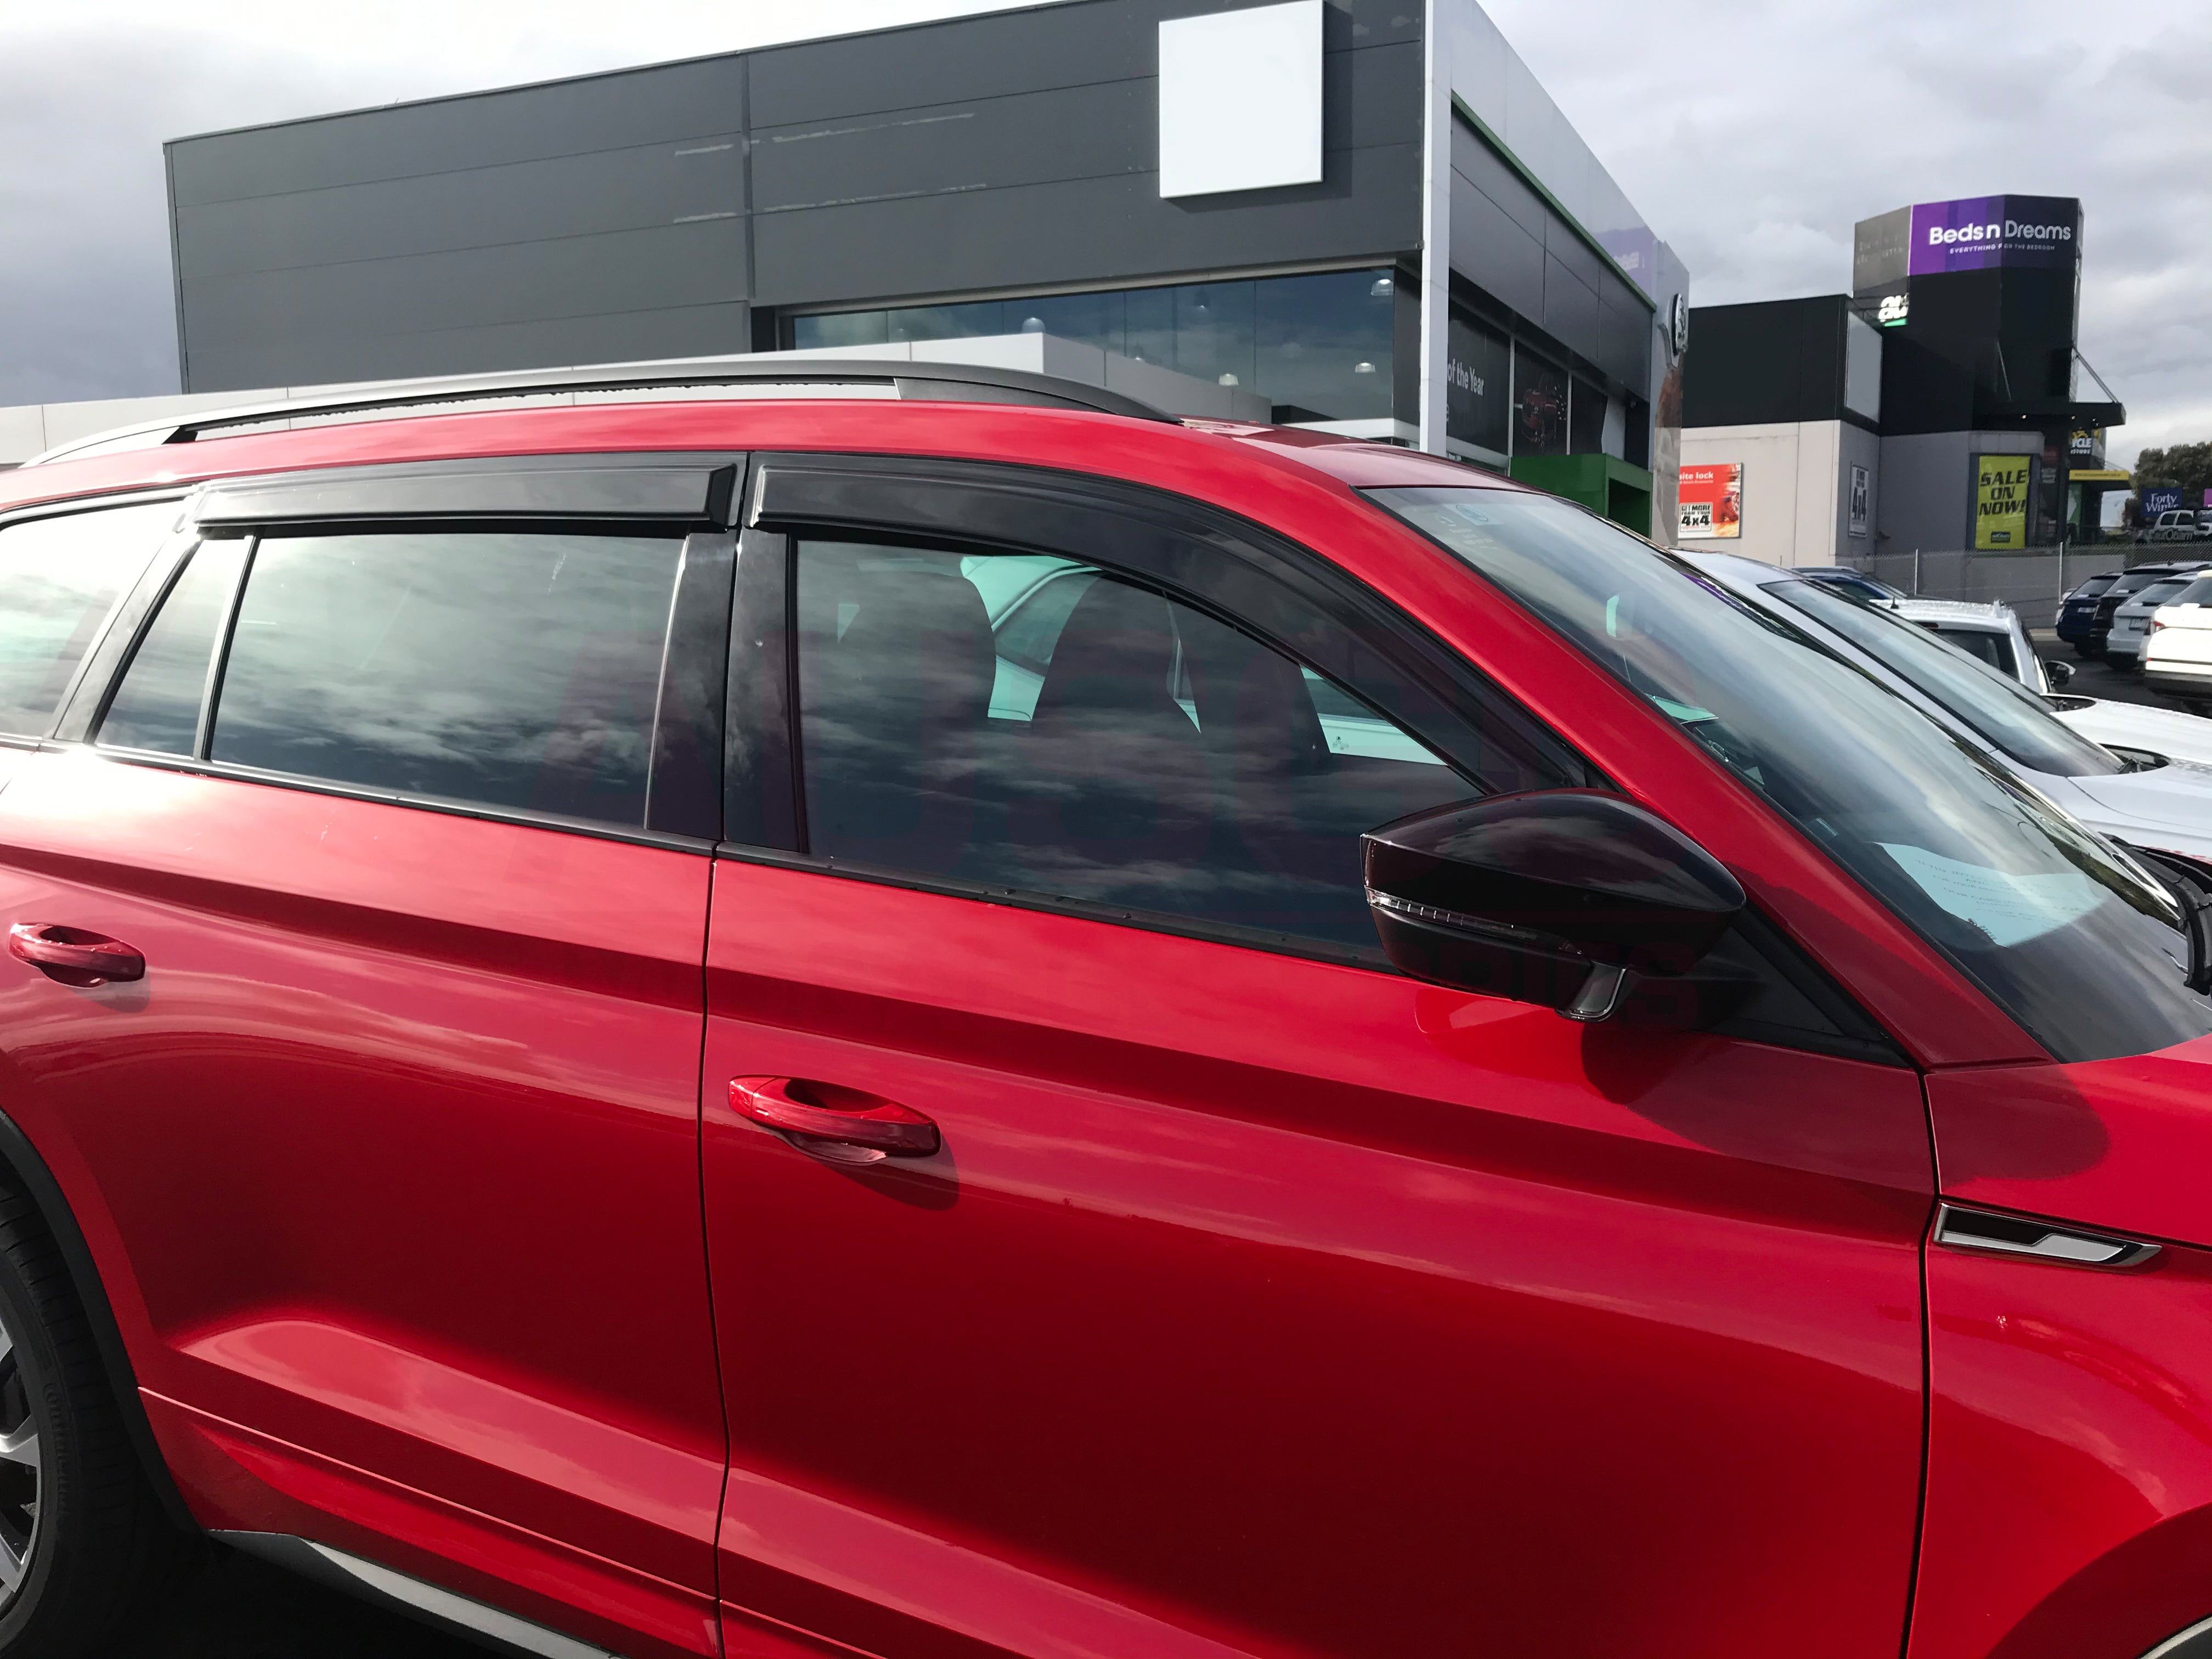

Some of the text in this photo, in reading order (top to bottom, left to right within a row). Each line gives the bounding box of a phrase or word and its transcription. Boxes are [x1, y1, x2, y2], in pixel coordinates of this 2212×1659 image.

[1929, 219, 2071, 245] Beds n Dreams
[1949, 244, 1996, 254] EVERYTHING
[1447, 358, 1485, 396] of the Year
[1696, 471, 1714, 479] lock
[1980, 469, 2028, 487] SALE
[1990, 486, 2016, 500] ON
[2151, 493, 2177, 504] Forty
[1979, 498, 2027, 516] NOW!
